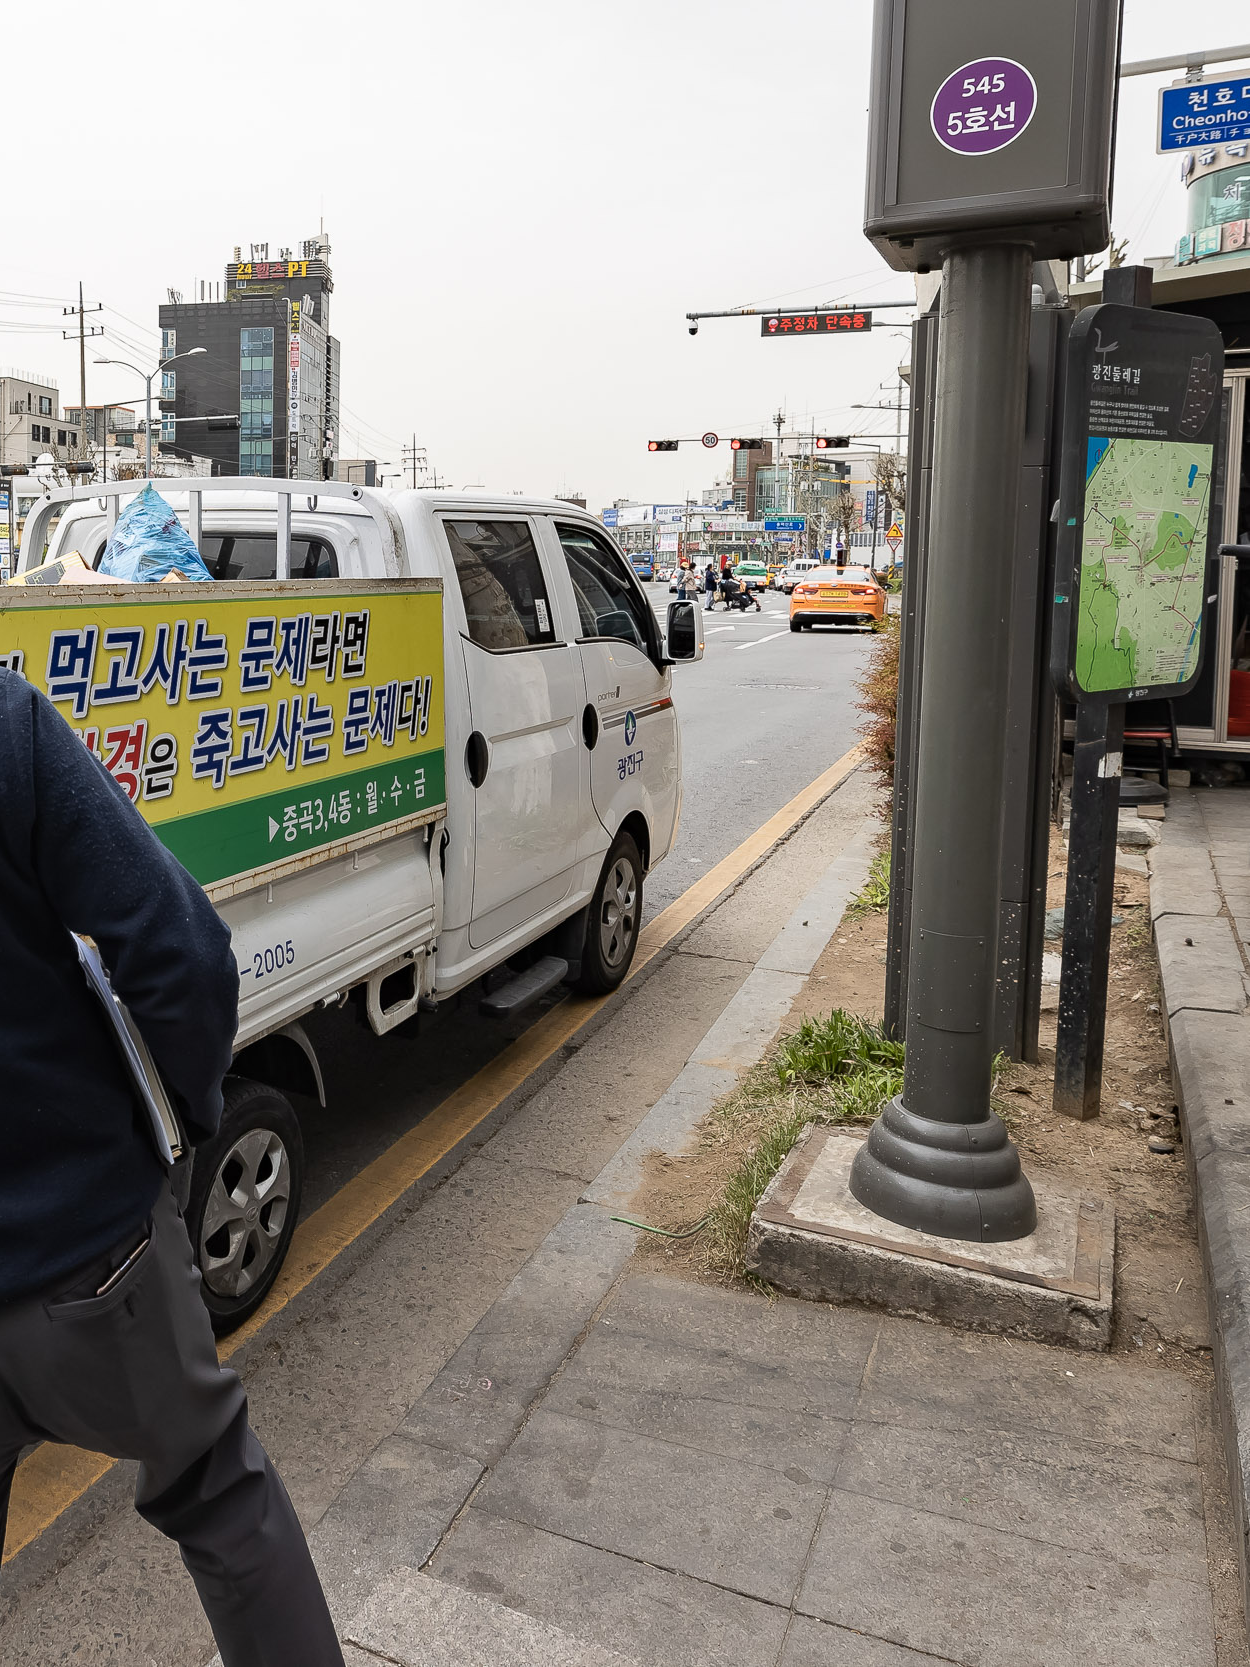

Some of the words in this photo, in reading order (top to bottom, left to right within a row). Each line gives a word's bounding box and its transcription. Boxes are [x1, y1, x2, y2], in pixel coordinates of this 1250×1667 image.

[961, 73, 1005, 98] 545
[947, 101, 1016, 136] 5호선
[1172, 109, 1250, 129] Cheonho
[237, 263, 252, 274] 24
[288, 261, 309, 277] PT
[780, 316, 818, 332] 주정차
[826, 313, 866, 330] 단속중
[1092, 364, 1141, 384] 광진둘레길
[705, 436, 716, 444] 50
[47, 620, 227, 717] 먹고사는
[240, 610, 369, 692] 문제라면
[191, 693, 333, 788] 죽고사는
[342, 676, 431, 755] 문제다!
[617, 750, 644, 780] 광진구
